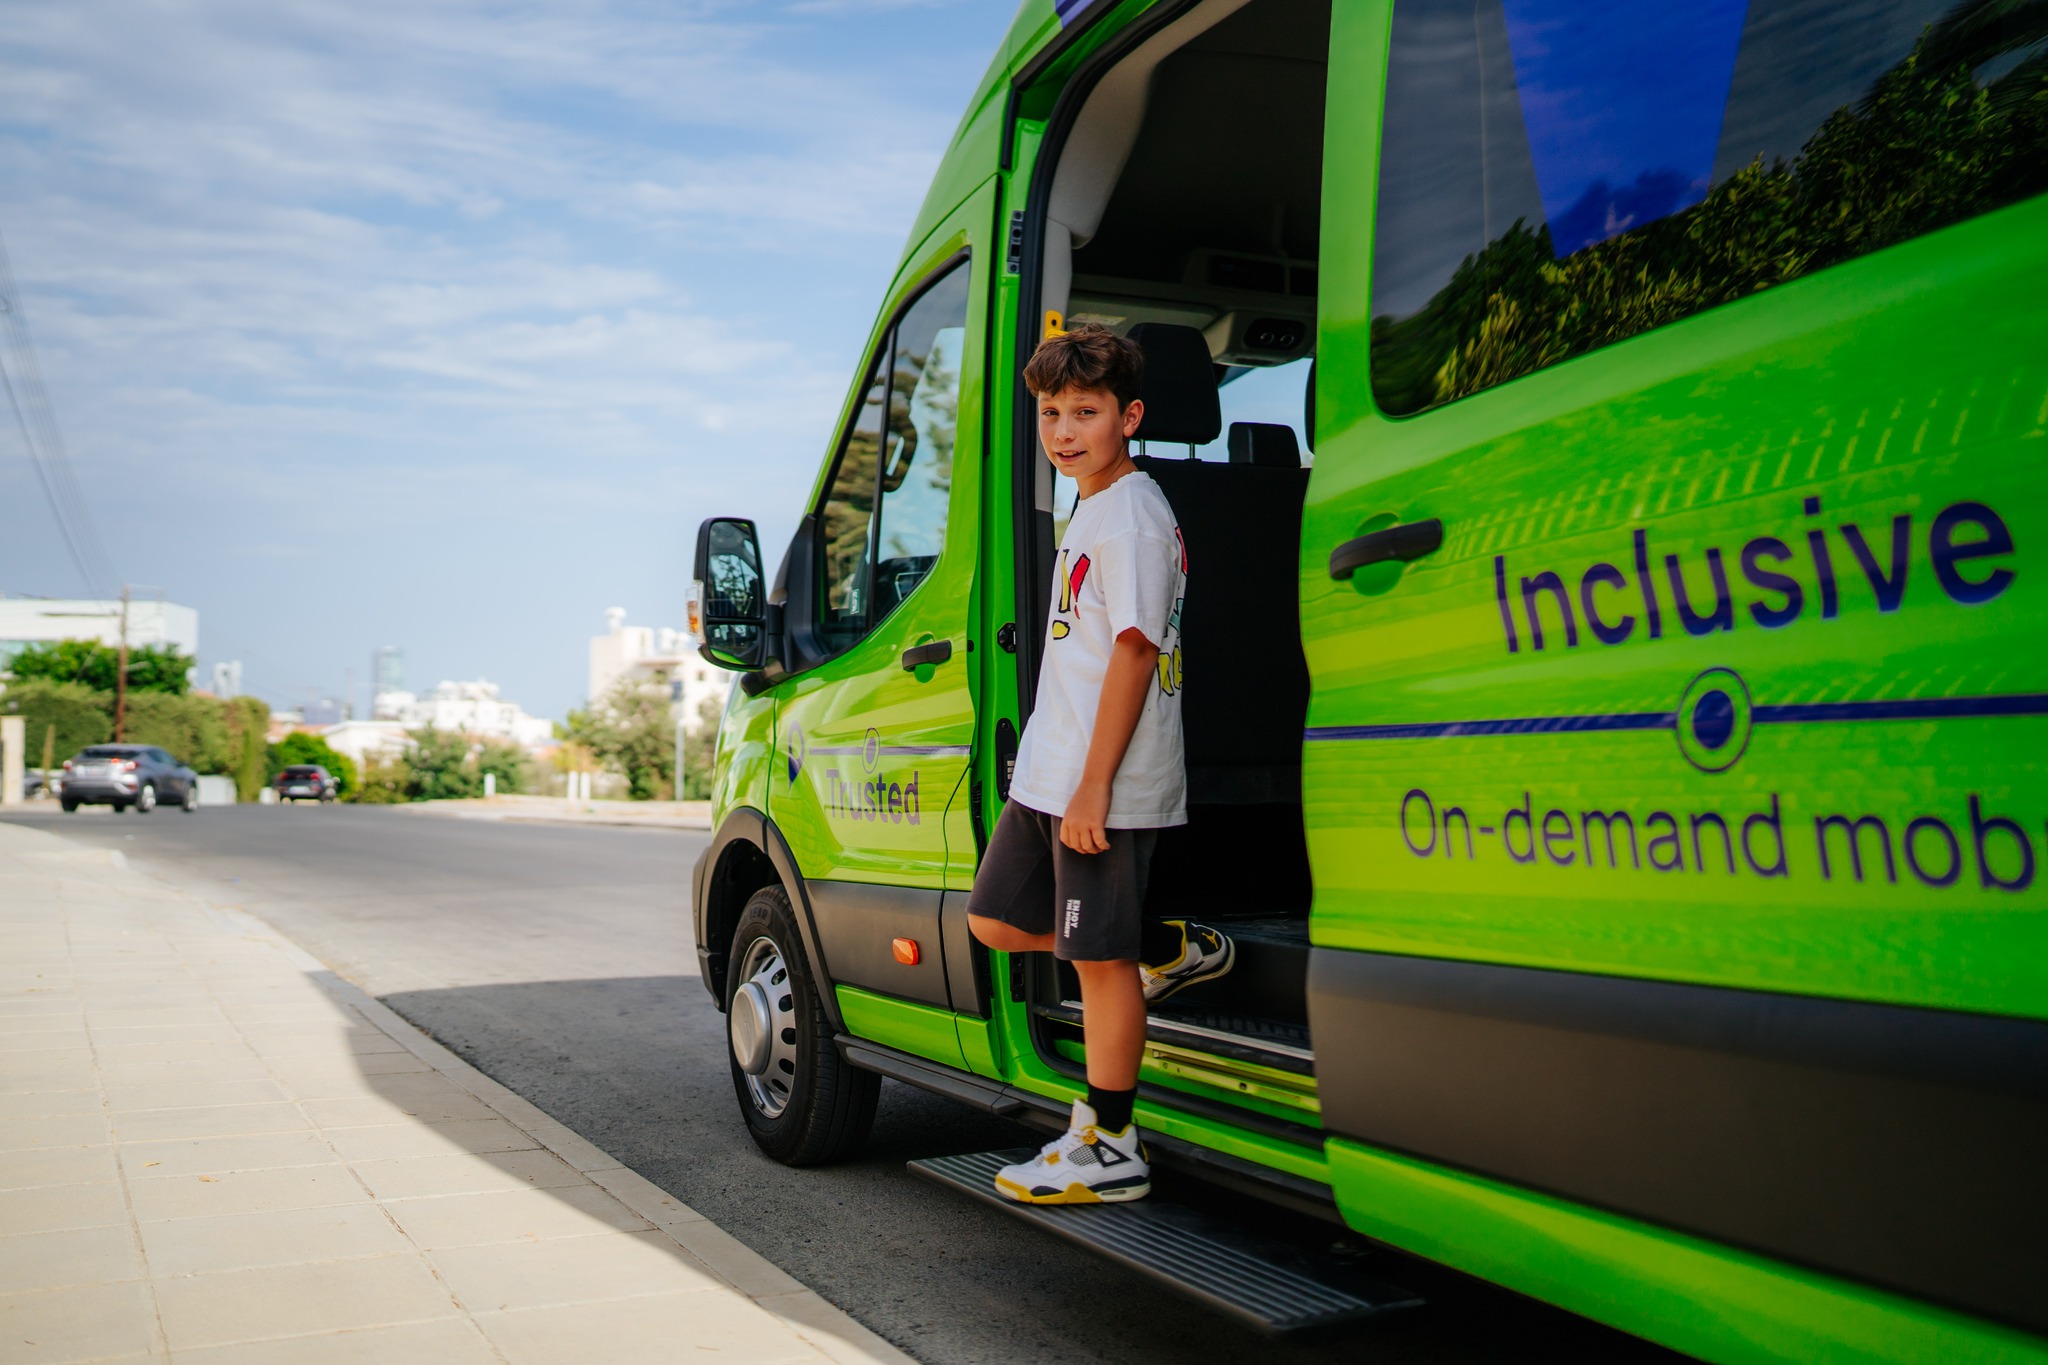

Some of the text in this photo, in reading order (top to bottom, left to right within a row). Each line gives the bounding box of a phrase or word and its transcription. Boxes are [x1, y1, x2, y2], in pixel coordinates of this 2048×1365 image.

[1493, 496, 2017, 653] Inclusive
[825, 769, 921, 826] Trusted
[1400, 788, 2048, 893] On-demand mob
[1070, 899, 1081, 929] ENJOY
